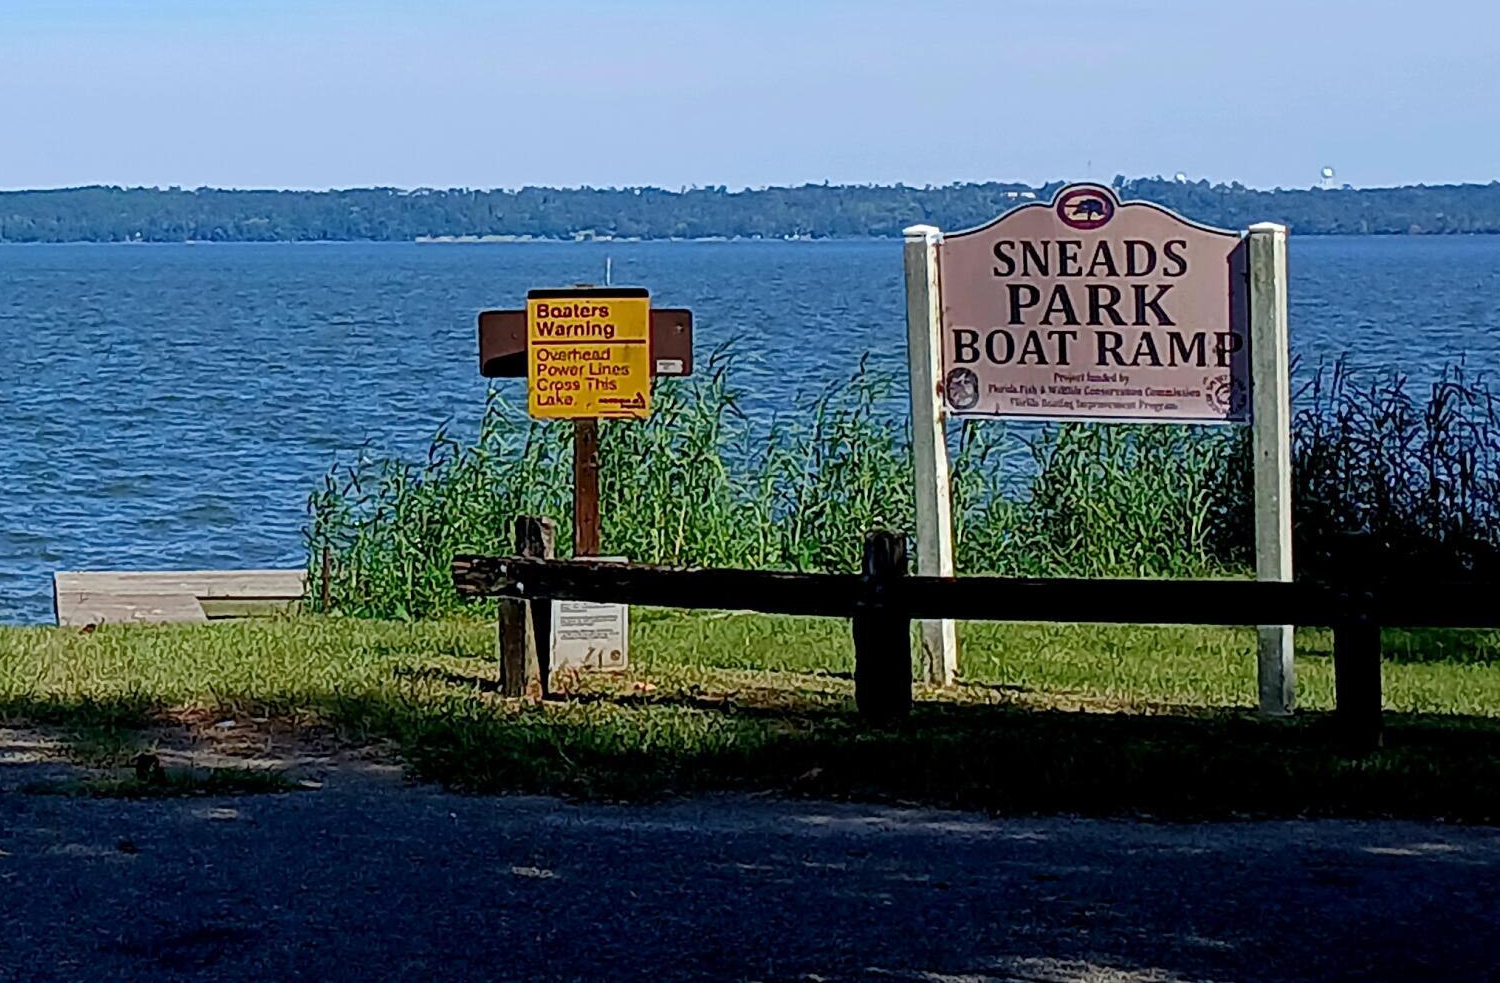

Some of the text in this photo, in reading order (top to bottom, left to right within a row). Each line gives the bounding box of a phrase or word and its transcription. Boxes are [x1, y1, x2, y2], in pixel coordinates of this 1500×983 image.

[993, 240, 1188, 277] SNEADS
[536, 303, 609, 319] Boaters
[1007, 284, 1176, 326] PARK
[536, 321, 615, 339] Warning
[536, 348, 611, 362] Overhead
[952, 329, 1244, 368] BOAT RAMP
[537, 362, 630, 377] Power Lines
[536, 377, 618, 391] Cross This
[1119, 373, 1129, 385] by
[1020, 384, 1038, 395] Fish
